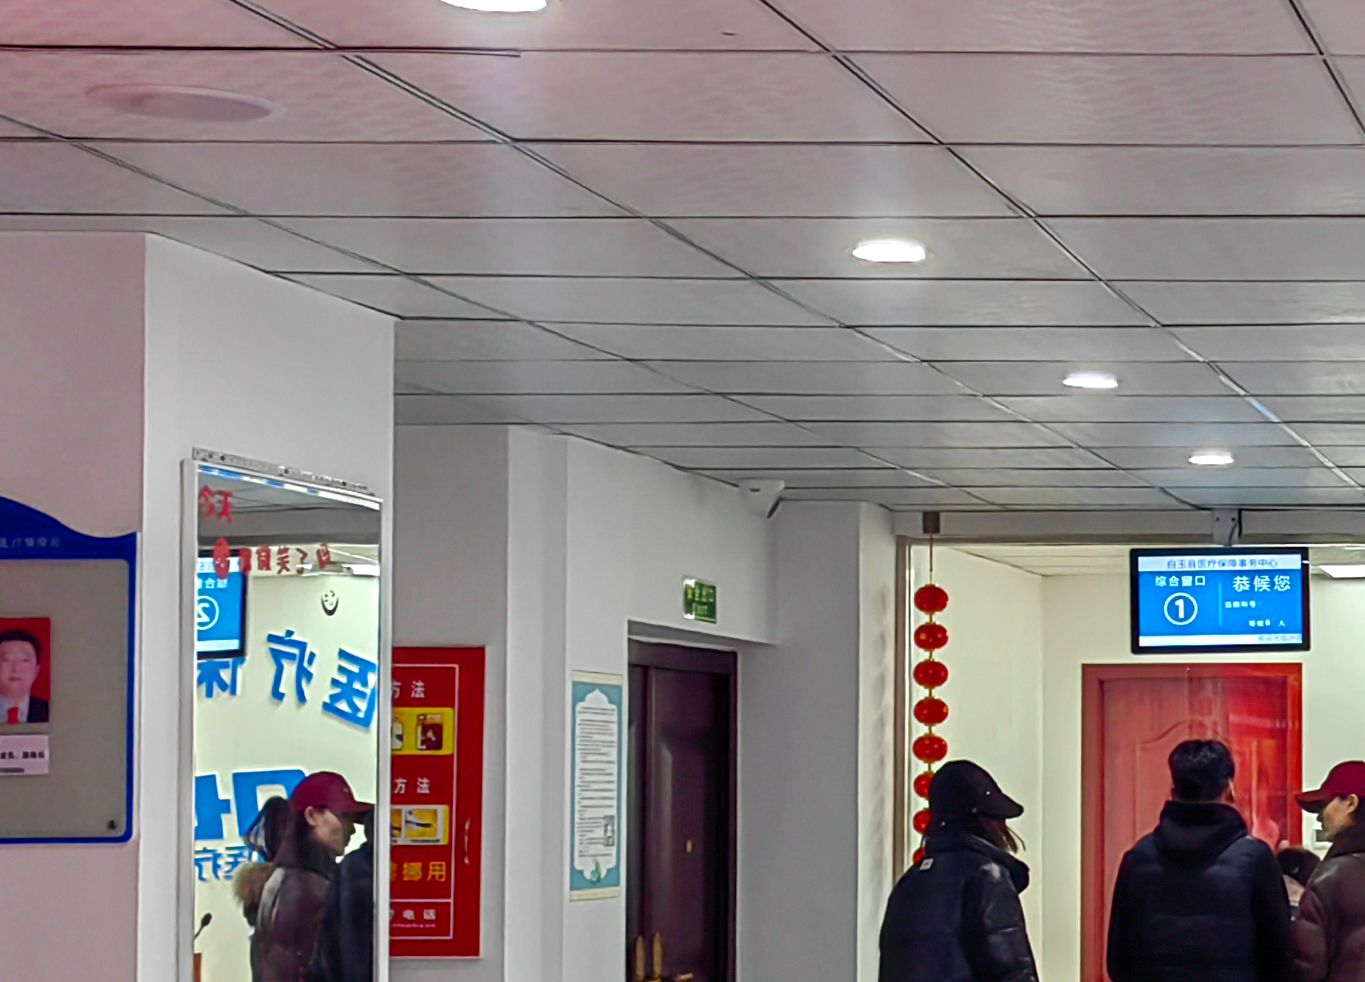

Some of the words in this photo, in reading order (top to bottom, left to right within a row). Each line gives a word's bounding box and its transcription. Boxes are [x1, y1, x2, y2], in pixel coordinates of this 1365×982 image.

[1155, 576, 1206, 587] 综合窗口
[1232, 576, 1291, 592] 恭候您
